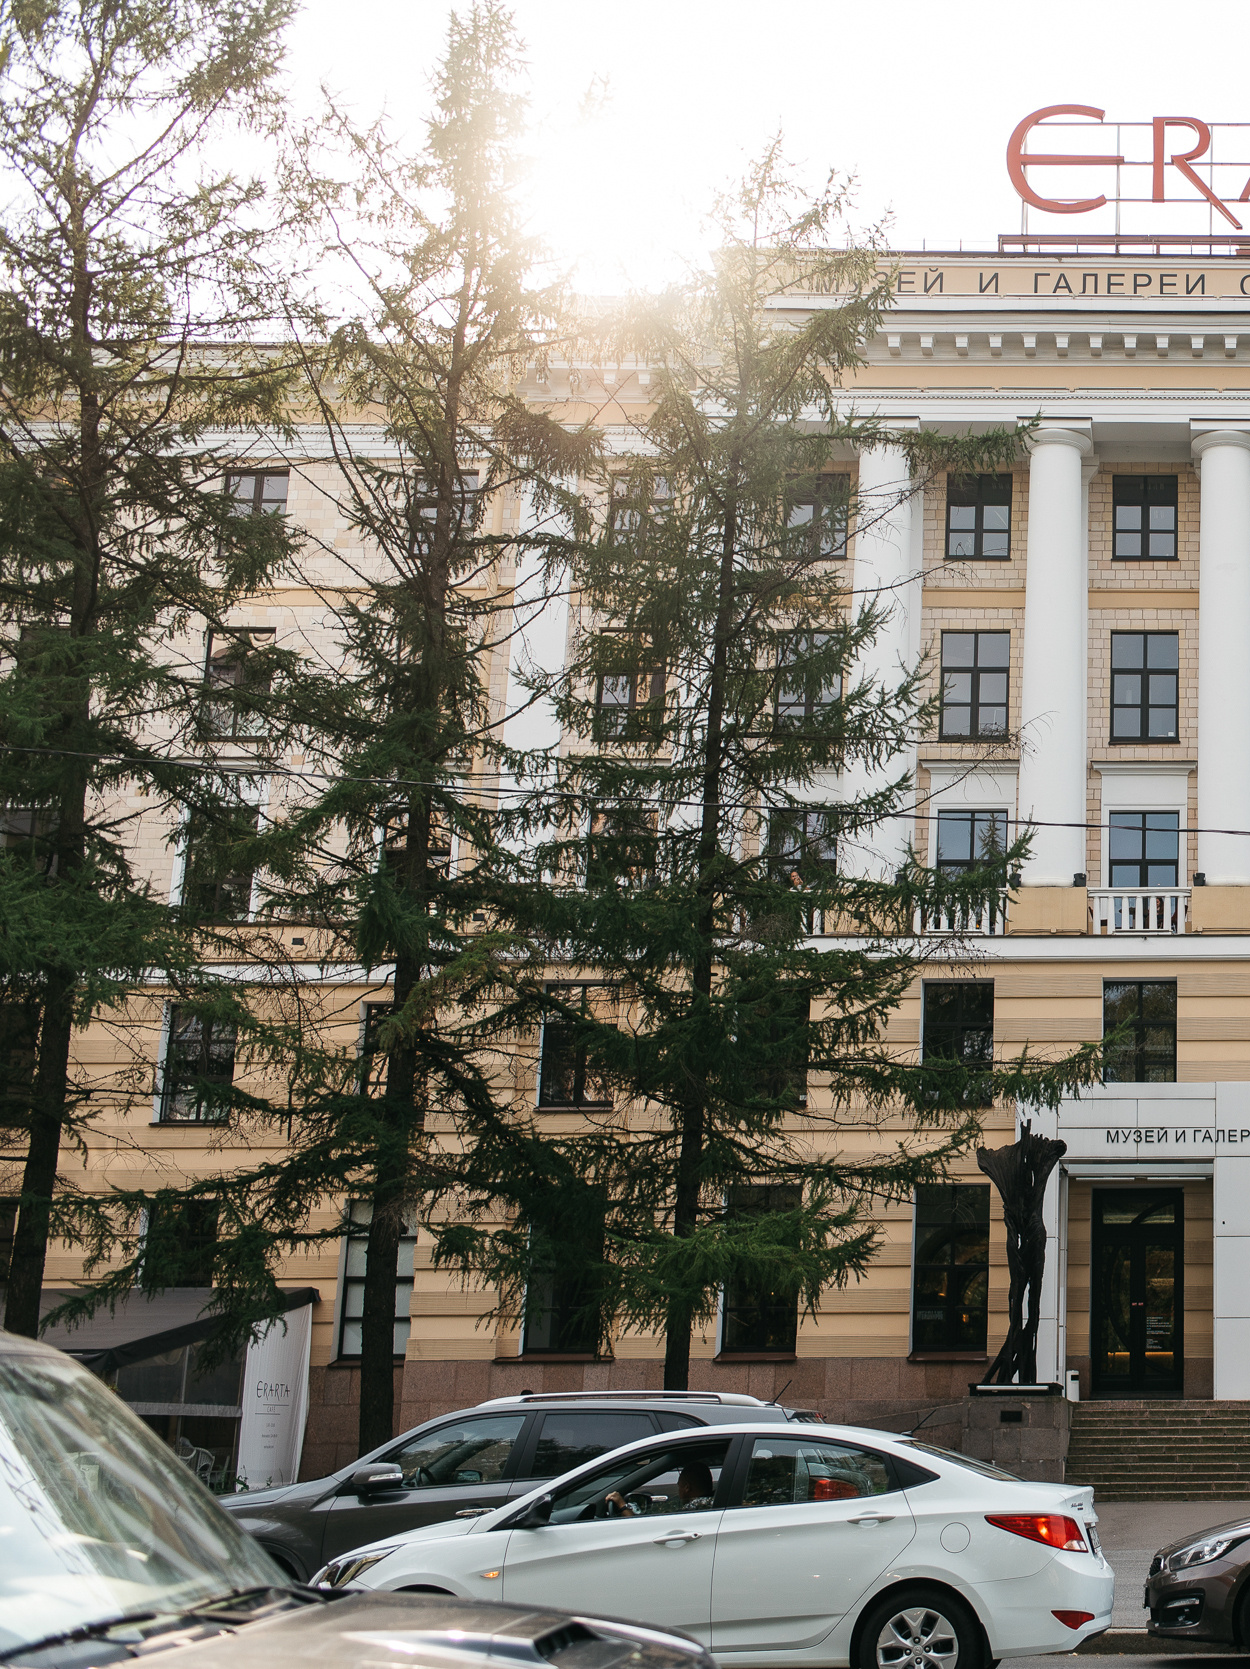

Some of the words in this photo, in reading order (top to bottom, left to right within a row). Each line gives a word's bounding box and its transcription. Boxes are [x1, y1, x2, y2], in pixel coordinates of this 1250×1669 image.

[978, 272, 999, 295] И
[1033, 272, 1207, 296] ГАЛЕРЕИ
[1106, 1126, 1168, 1144] МУЗЕЙ
[1175, 1129, 1187, 1143] И
[256, 1380, 290, 1401] ERARTA
